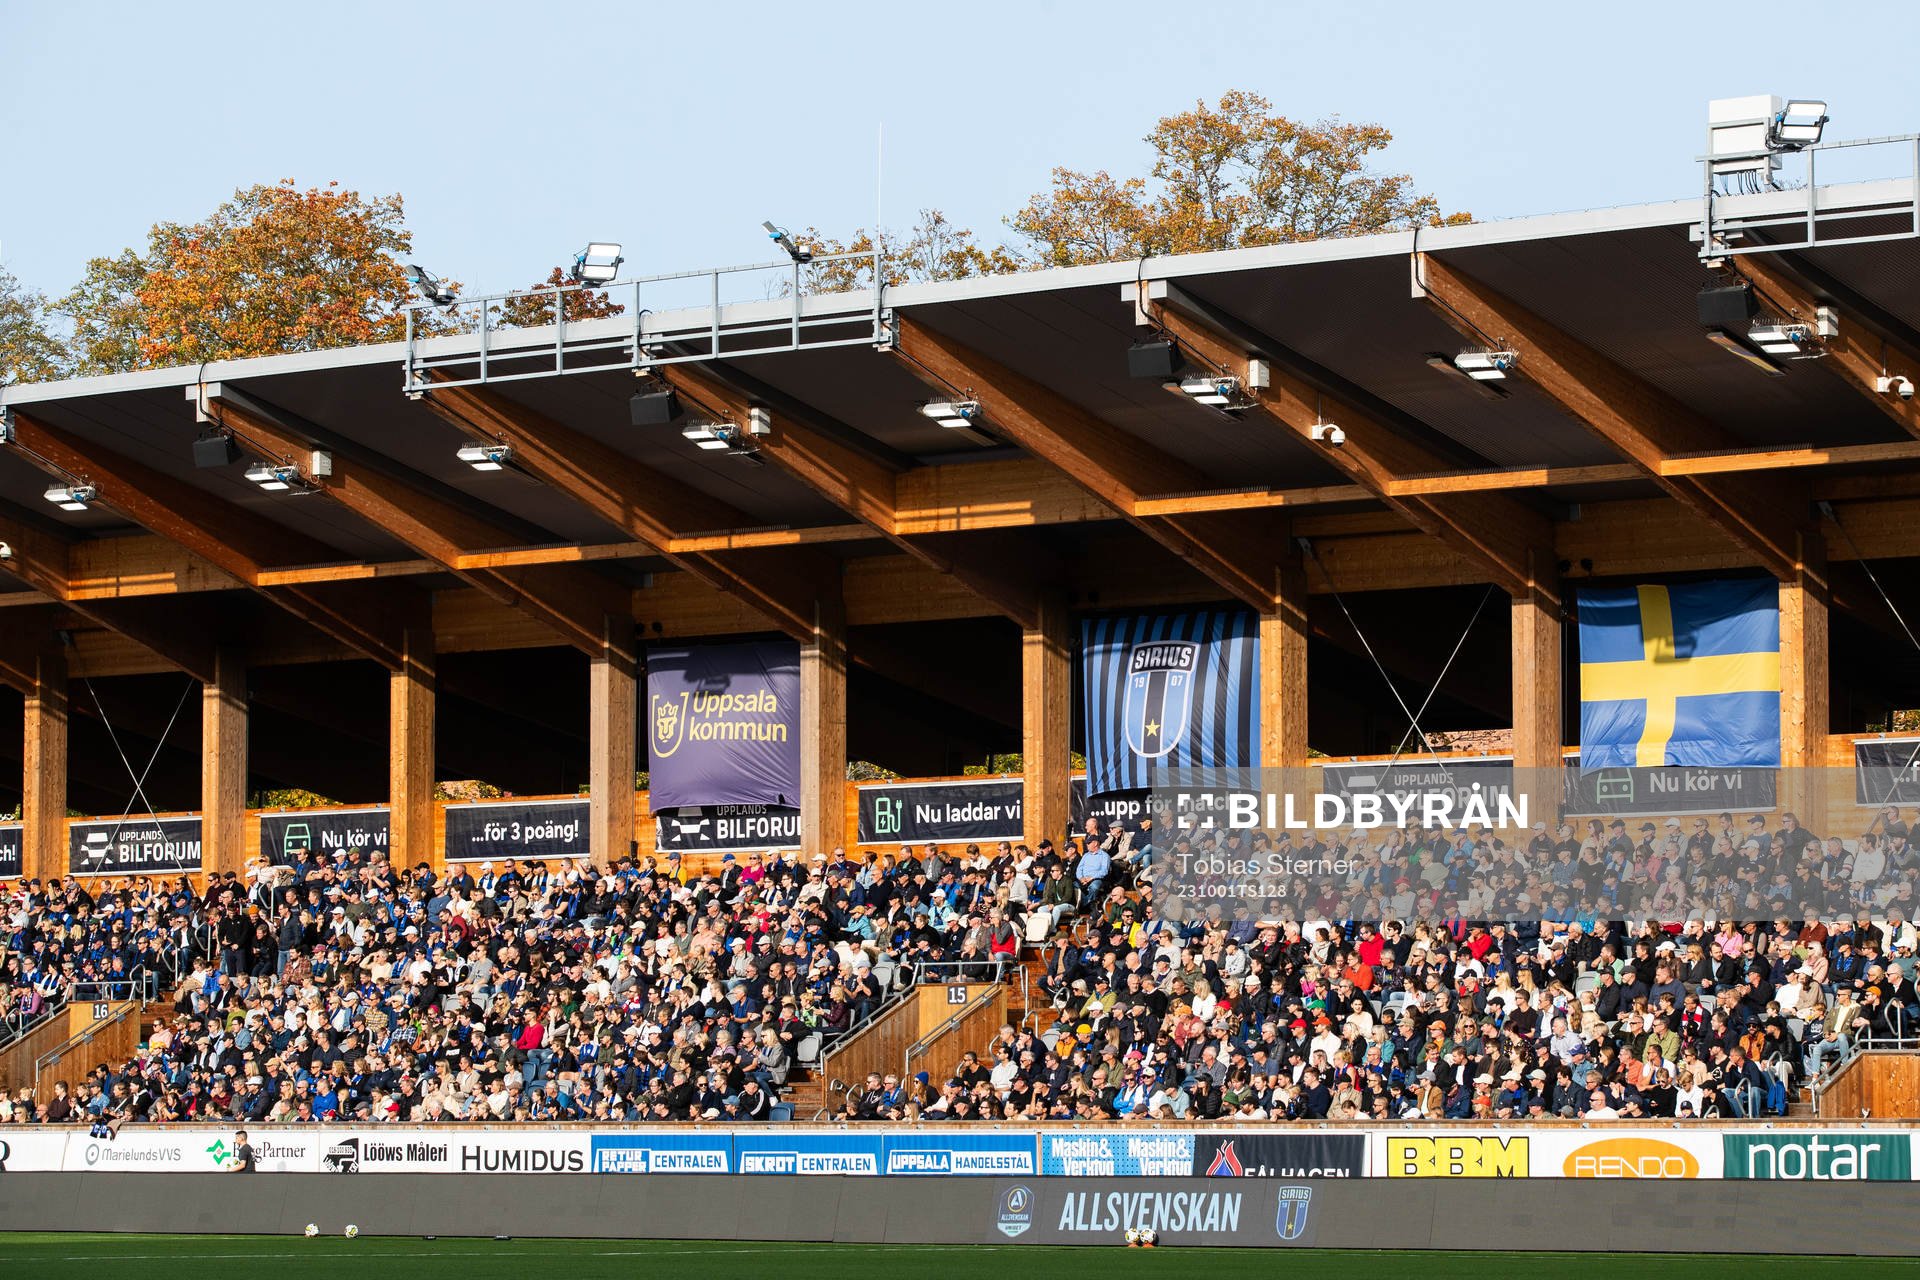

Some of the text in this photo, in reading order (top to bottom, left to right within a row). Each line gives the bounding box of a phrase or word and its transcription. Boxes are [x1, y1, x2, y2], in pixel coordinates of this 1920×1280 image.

[1134, 647, 1192, 669] SIRIUS
[1134, 675, 1183, 688] 19 07
[693, 690, 777, 718] Uppsala
[689, 717, 787, 742] kommun
[1394, 773, 1454, 786] UPPLANDS
[1650, 769, 1742, 793] Nu kör vi
[717, 804, 767, 816] UPPLANDS
[916, 800, 1021, 824] Nu laddar vi
[1145, 793, 1172, 814] för
[119, 831, 163, 842] UPPLANDS
[322, 827, 387, 849] Nu kör vi
[511, 823, 520, 841] 3
[525, 820, 579, 844] poäng!
[119, 841, 201, 863] BILFORUM
[949, 987, 966, 1003] 15
[94, 1004, 108, 1019] 16
[364, 1143, 403, 1162] Lööws
[407, 1141, 448, 1162] Måleri
[461, 1146, 584, 1172] HUMIDUS
[602, 1150, 642, 1161] RETUR
[655, 1155, 722, 1168] CENTRALEN
[891, 1153, 1029, 1170] UPPSALA HANDELSSTÅL
[1387, 1136, 1530, 1178] BBM
[1748, 1135, 1881, 1179] notar
[602, 1161, 647, 1172] PAPPER
[745, 1156, 871, 1173] SKROT CENTRALEN
[1576, 1156, 1686, 1178] RENDO
[1281, 1188, 1309, 1200] SIRIUS
[1059, 1191, 1242, 1231] ALLSVENSKAN
